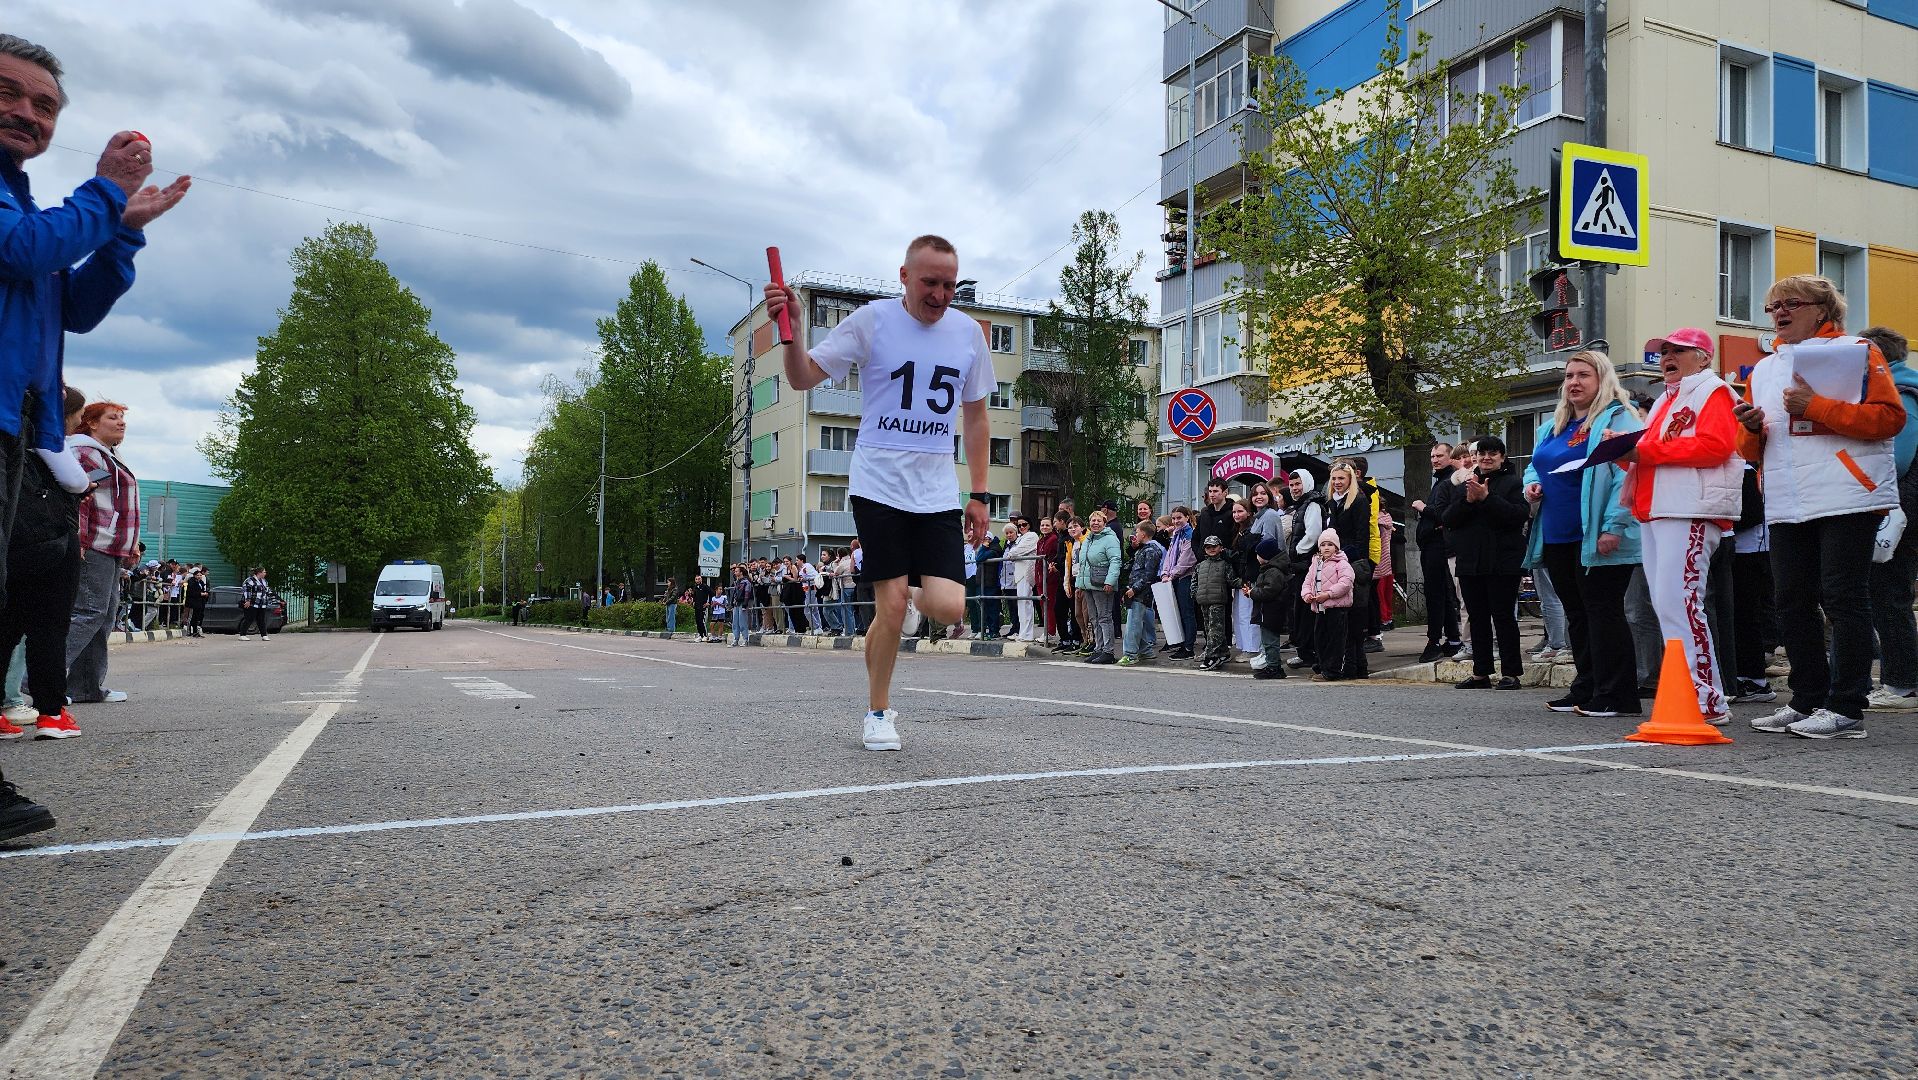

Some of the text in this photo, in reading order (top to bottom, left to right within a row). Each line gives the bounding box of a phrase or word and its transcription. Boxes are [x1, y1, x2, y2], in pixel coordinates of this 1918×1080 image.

[890, 360, 960, 414] 15
[878, 415, 949, 436] КАШИРА
[1215, 455, 1270, 477] ПРЕМЬЕР
